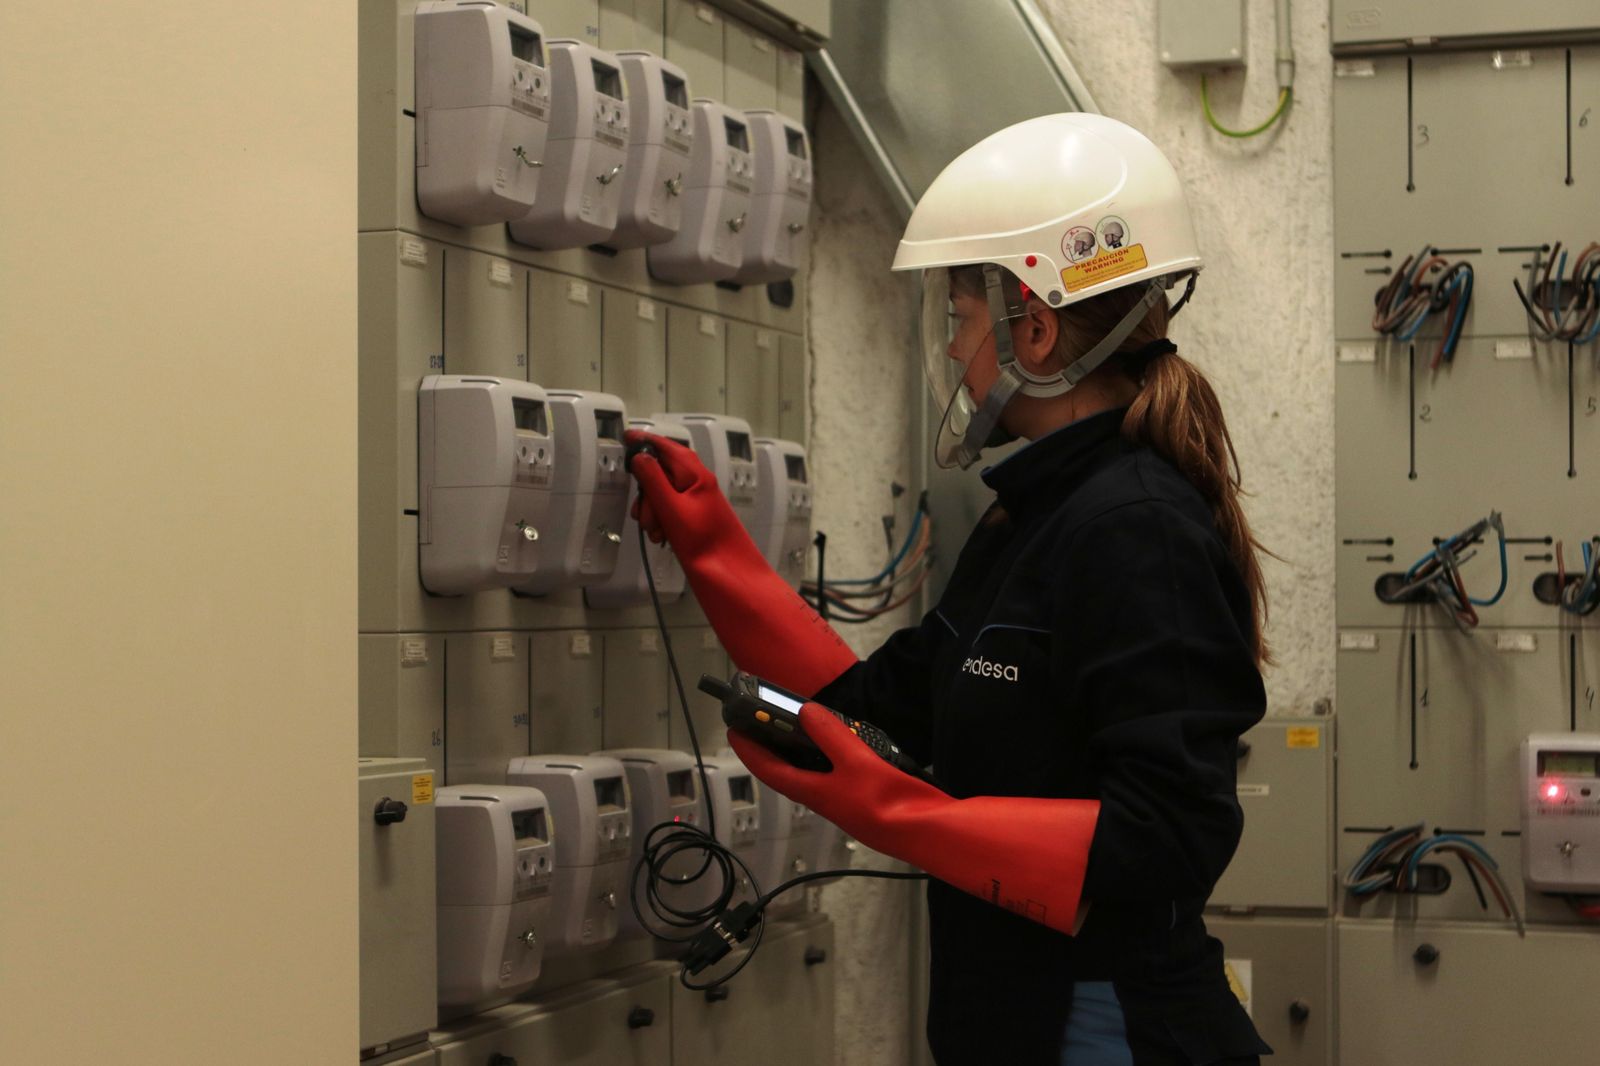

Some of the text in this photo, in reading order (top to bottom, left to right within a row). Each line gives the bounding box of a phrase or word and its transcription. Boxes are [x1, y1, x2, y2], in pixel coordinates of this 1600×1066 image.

[1417, 125, 1429, 146] 3
[1084, 257, 1124, 273] WARNING
[1419, 405, 1432, 422] 2
[1585, 397, 1597, 417] 5
[1420, 688, 1428, 706] 1
[1585, 686, 1594, 711] 4
